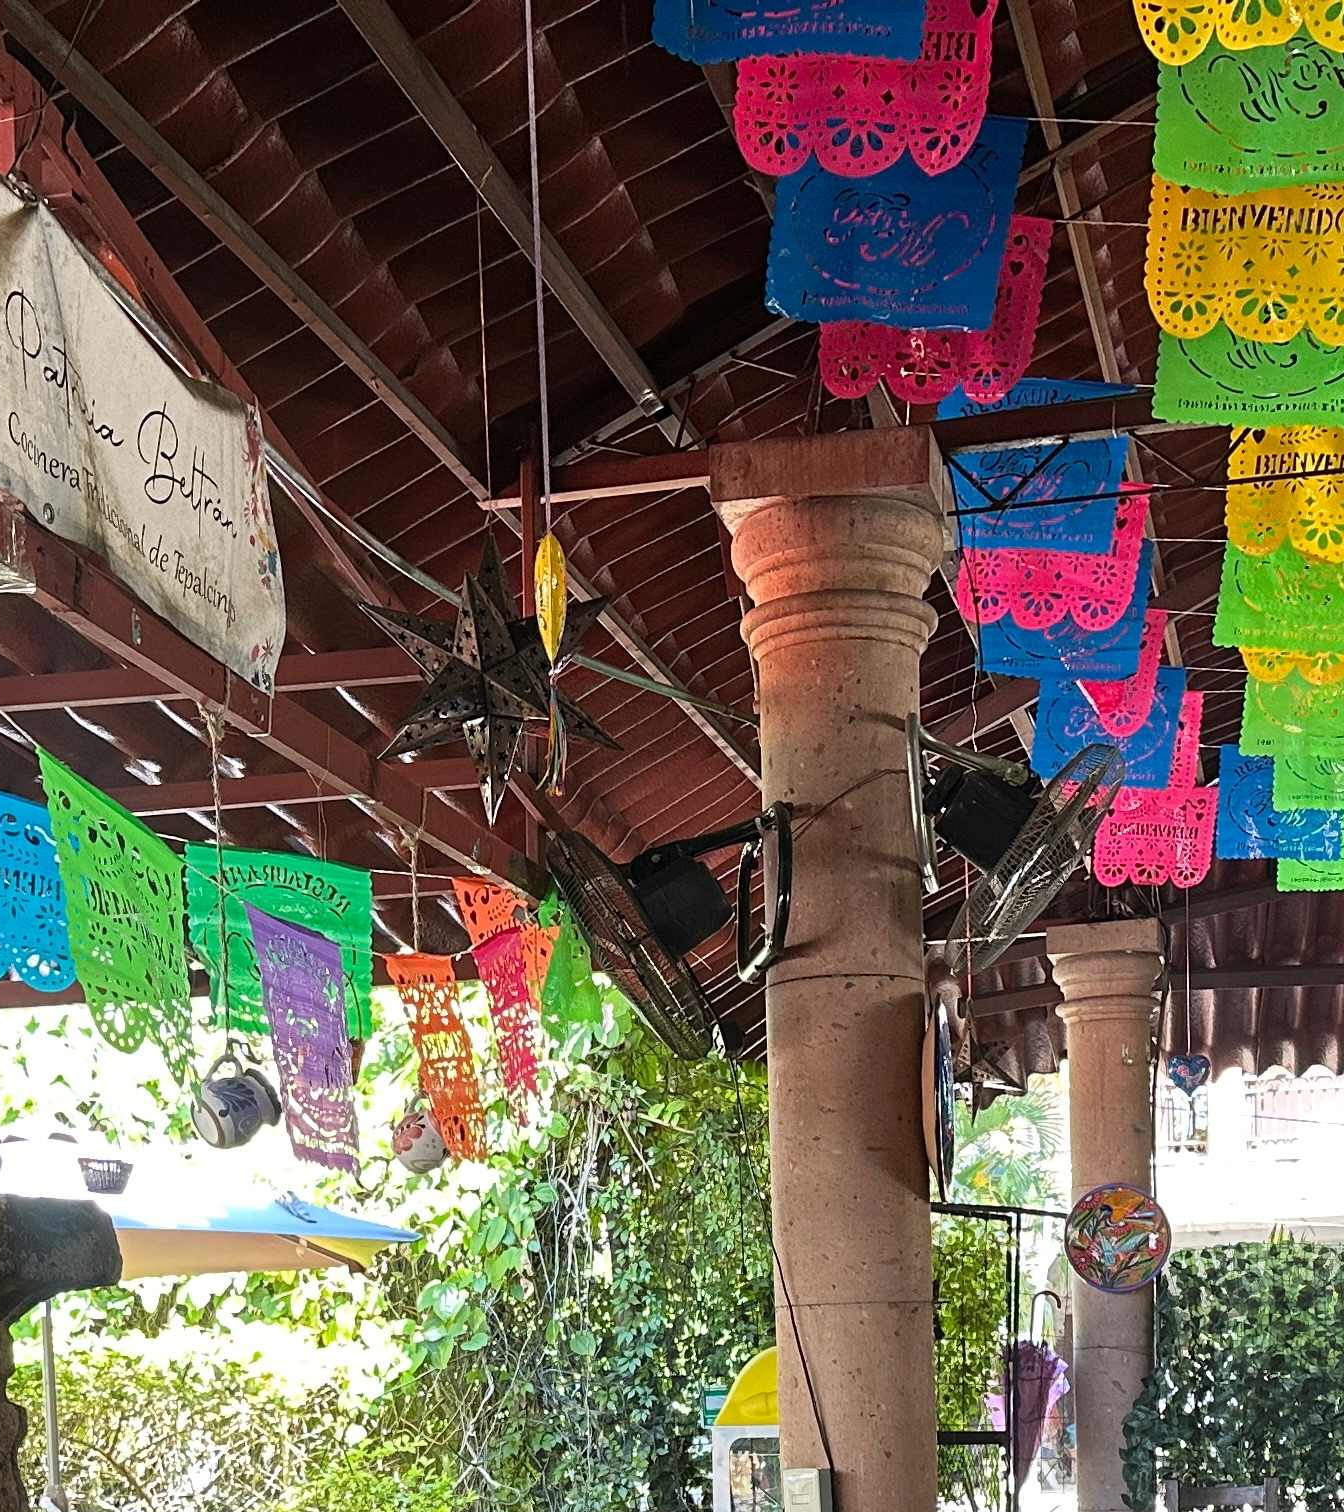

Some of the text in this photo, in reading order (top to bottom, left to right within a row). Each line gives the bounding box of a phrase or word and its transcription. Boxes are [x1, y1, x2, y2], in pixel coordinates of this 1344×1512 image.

[8, 412, 81, 492] Cocinera
[149, 534, 169, 572] de
[137, 401, 238, 538] Beltrán
